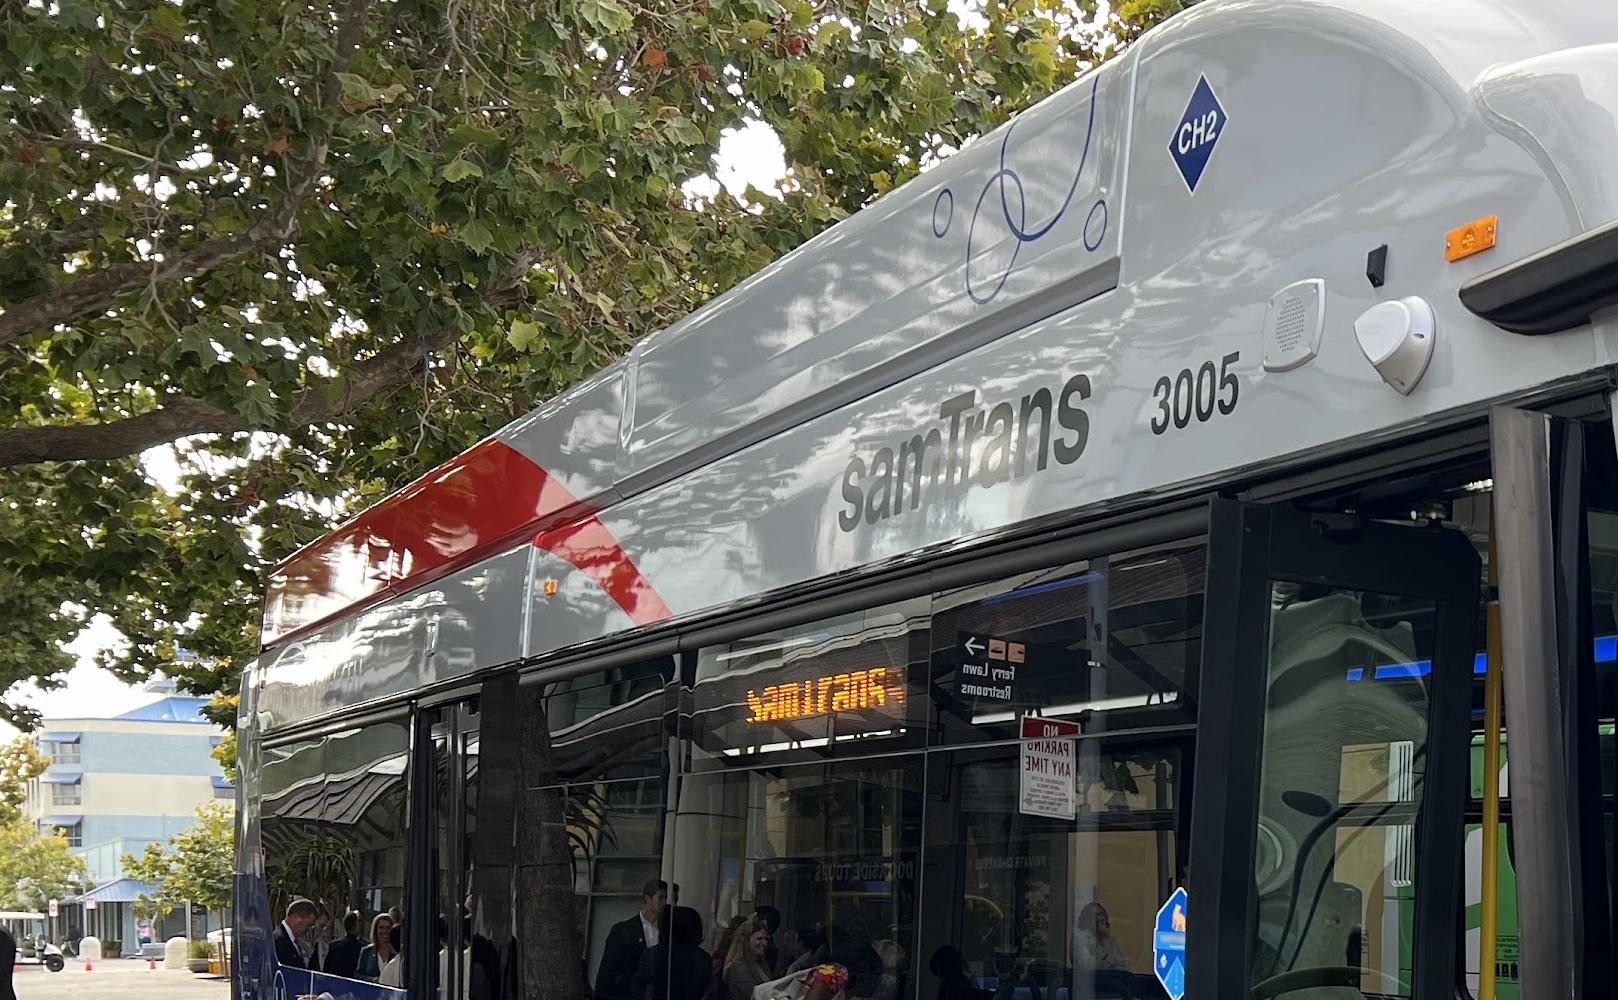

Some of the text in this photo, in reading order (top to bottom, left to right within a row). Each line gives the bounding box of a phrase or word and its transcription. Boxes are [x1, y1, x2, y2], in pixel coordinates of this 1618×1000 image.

[1178, 110, 1217, 155] CH2
[1150, 351, 1240, 436] 3005
[838, 374, 1092, 532] samTrans
